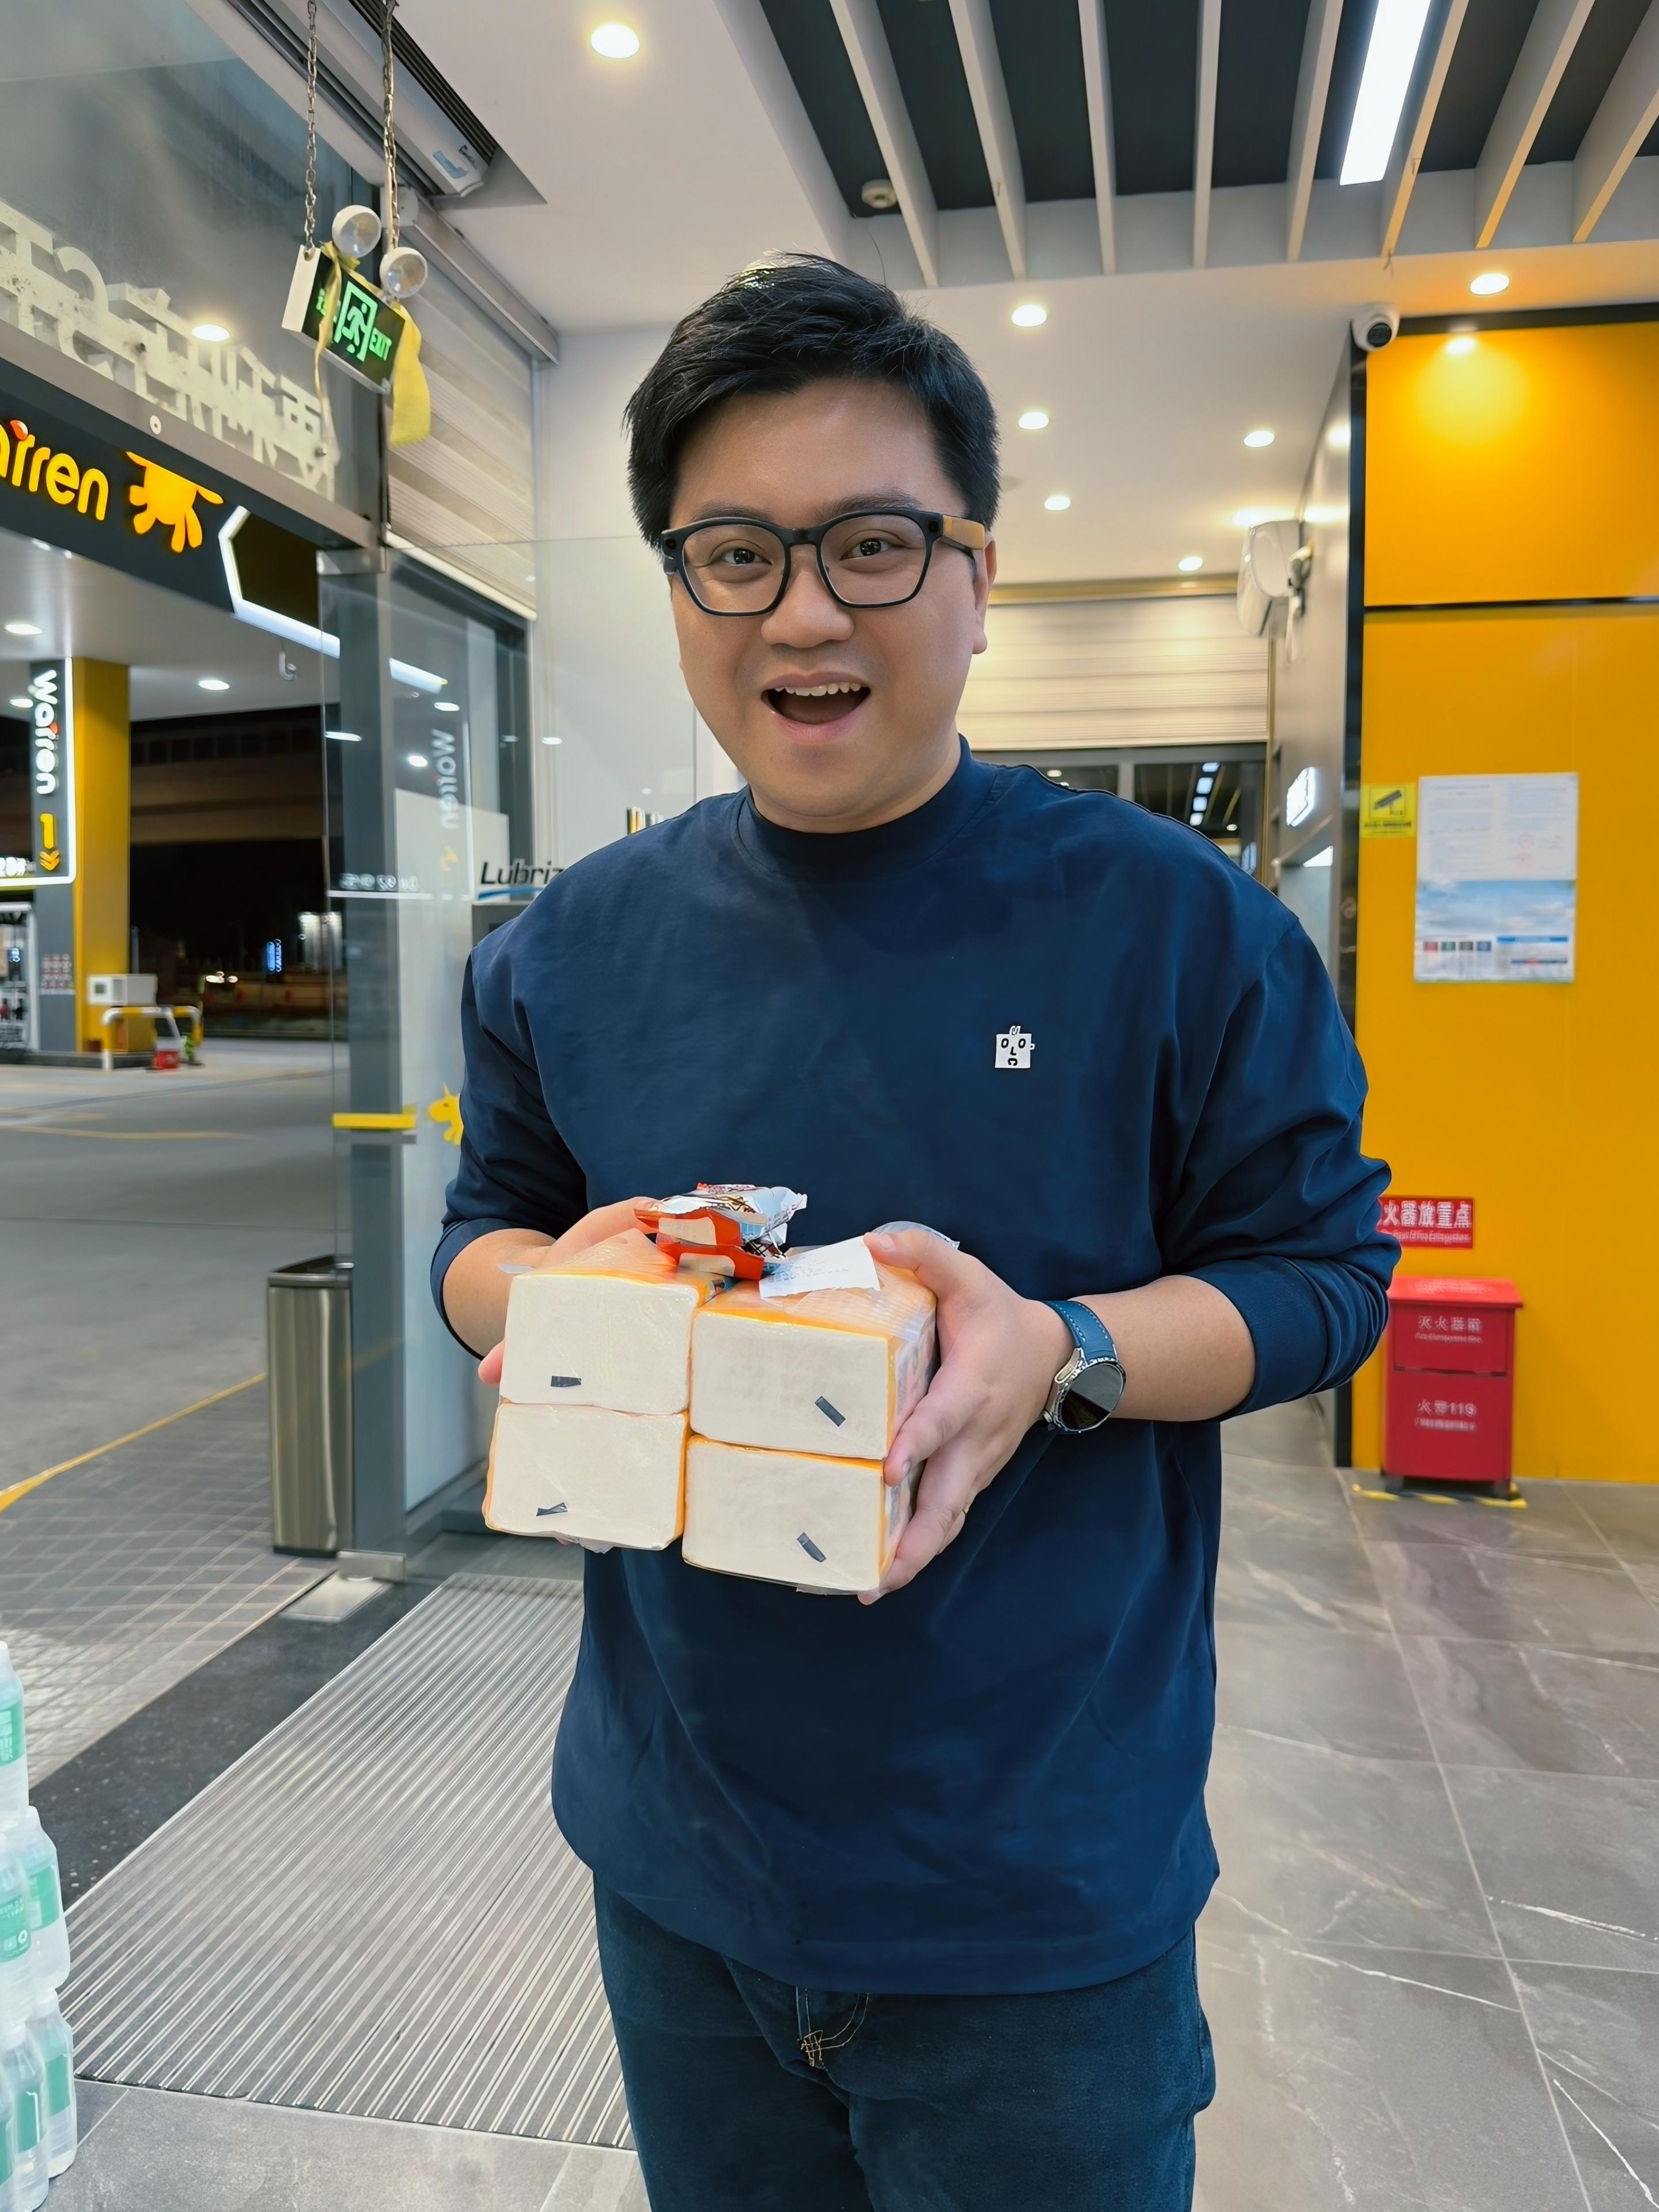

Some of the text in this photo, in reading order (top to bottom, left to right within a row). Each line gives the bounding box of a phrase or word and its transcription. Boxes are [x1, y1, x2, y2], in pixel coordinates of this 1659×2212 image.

[40, 813, 55, 849] 1
[1377, 1199, 1472, 1229] 火器放置点
